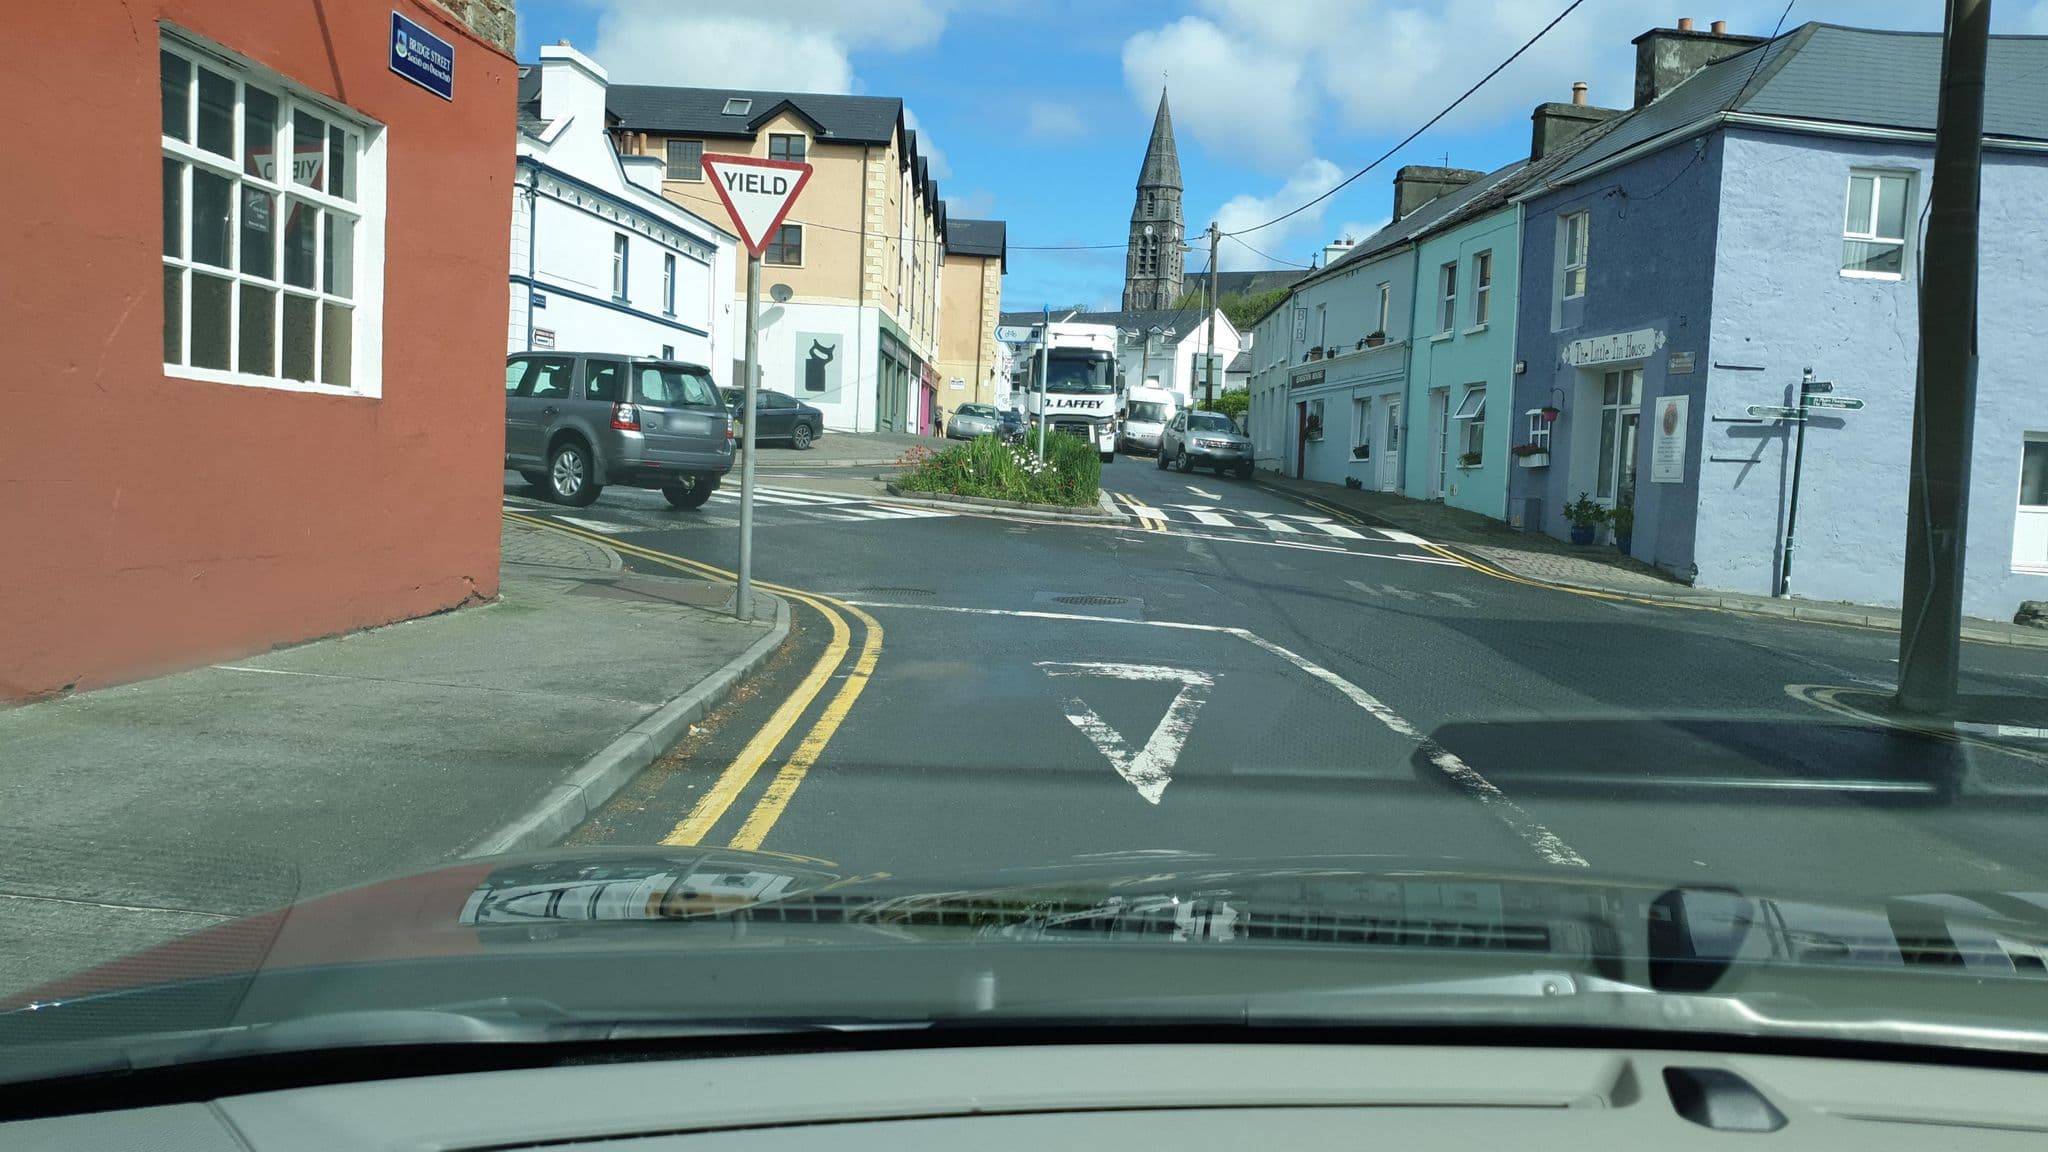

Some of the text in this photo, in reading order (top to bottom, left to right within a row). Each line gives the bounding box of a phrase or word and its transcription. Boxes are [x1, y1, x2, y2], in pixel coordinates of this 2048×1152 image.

[408, 37, 451, 72] BRIDGE STREET
[723, 171, 788, 196] YIELD
[1575, 342, 1588, 363] The
[1626, 334, 1646, 357] House
[1056, 399, 1104, 409] LAFFEY
